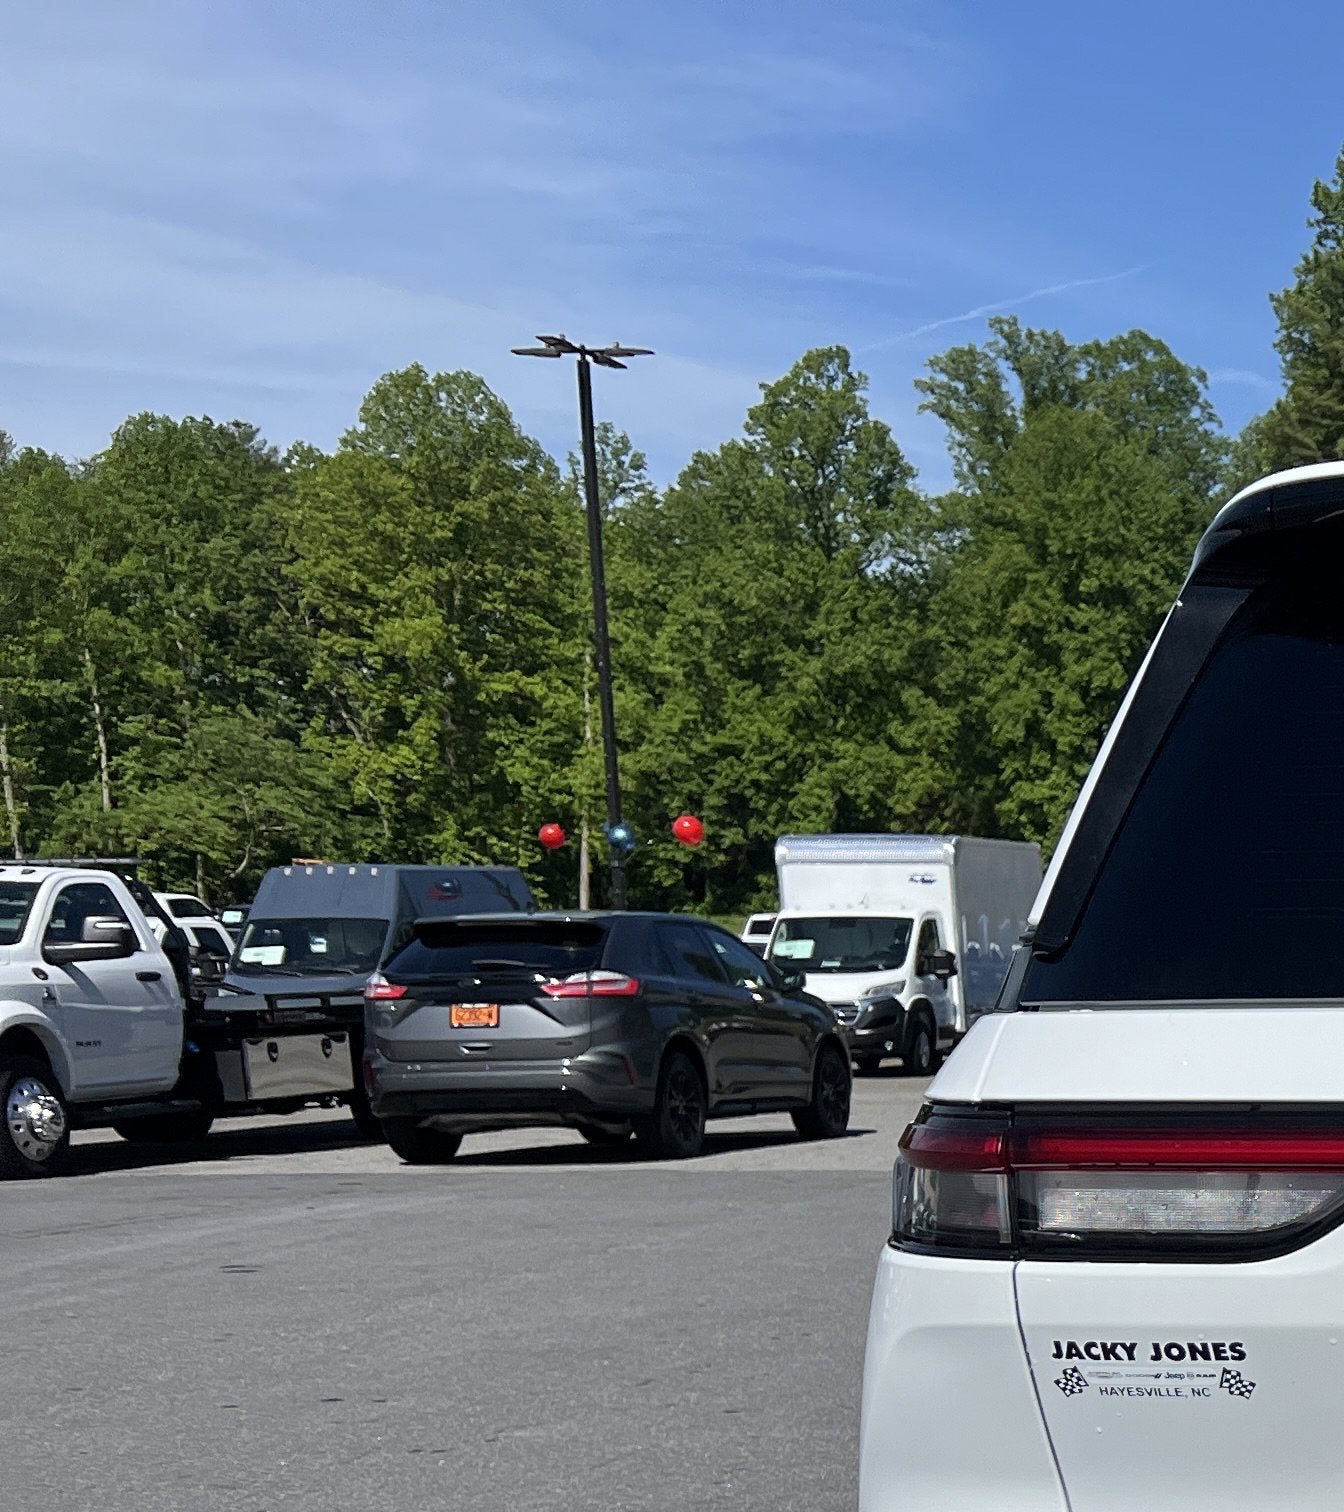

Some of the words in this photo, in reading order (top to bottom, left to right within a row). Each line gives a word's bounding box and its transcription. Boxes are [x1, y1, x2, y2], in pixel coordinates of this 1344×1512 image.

[1052, 1340, 1138, 1361] JACKY
[1149, 1341, 1247, 1361] JONES
[1099, 1386, 1188, 1398] HAYESVILLE,
[1192, 1387, 1211, 1397] NC
